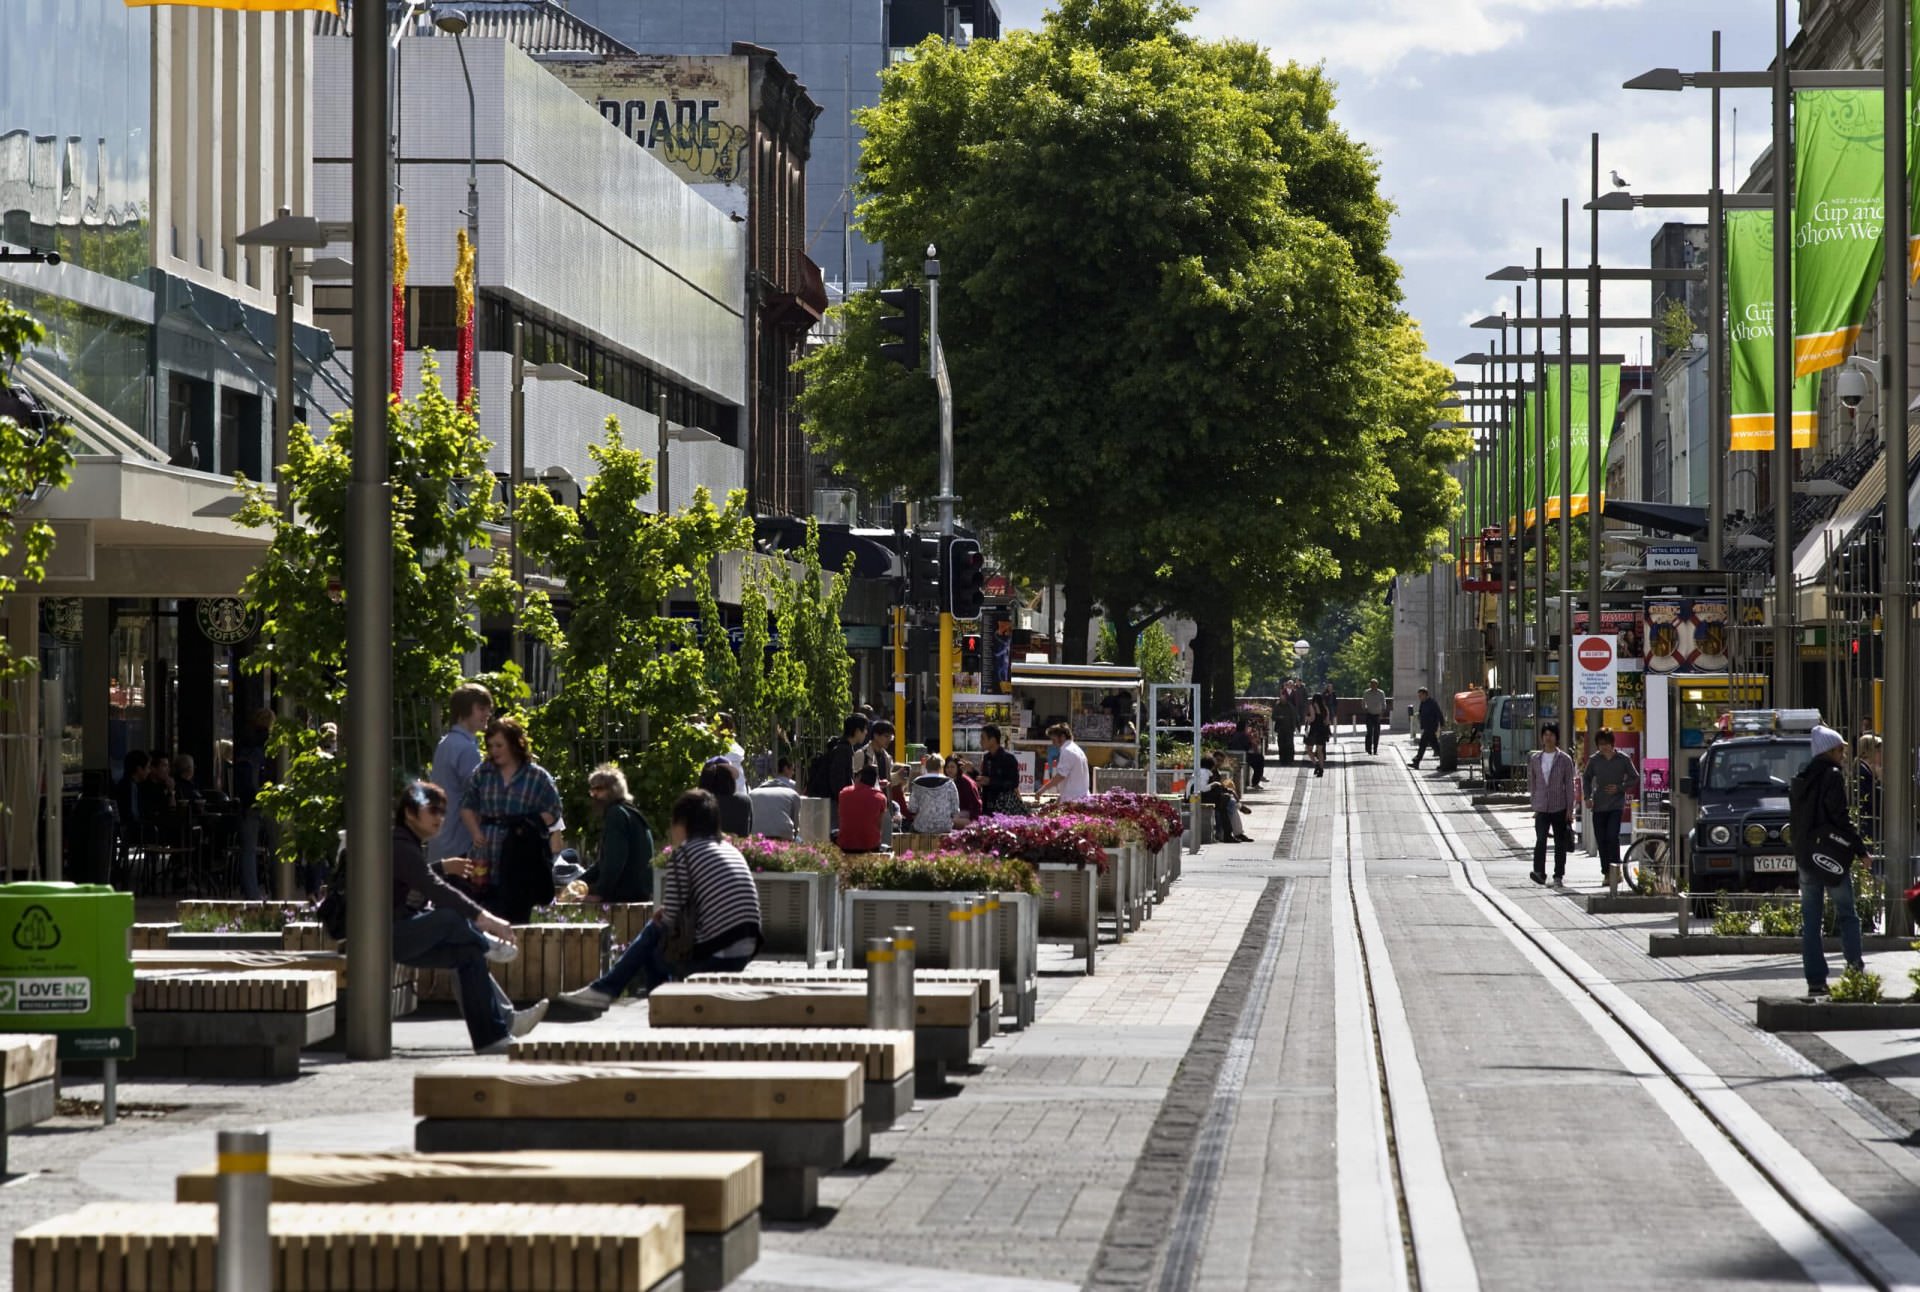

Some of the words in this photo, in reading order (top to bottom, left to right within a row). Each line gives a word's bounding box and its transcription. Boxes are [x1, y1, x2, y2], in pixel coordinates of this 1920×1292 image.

[596, 99, 720, 150] RCADE
[1814, 201, 1849, 226] Cup
[1796, 221, 1848, 249] Show
[1673, 559, 1691, 568] Doig
[208, 624, 250, 641] COFFEE
[1757, 857, 1794, 870] YG1747
[20, 983, 62, 996] LOVE
[65, 982, 87, 996] NZ
